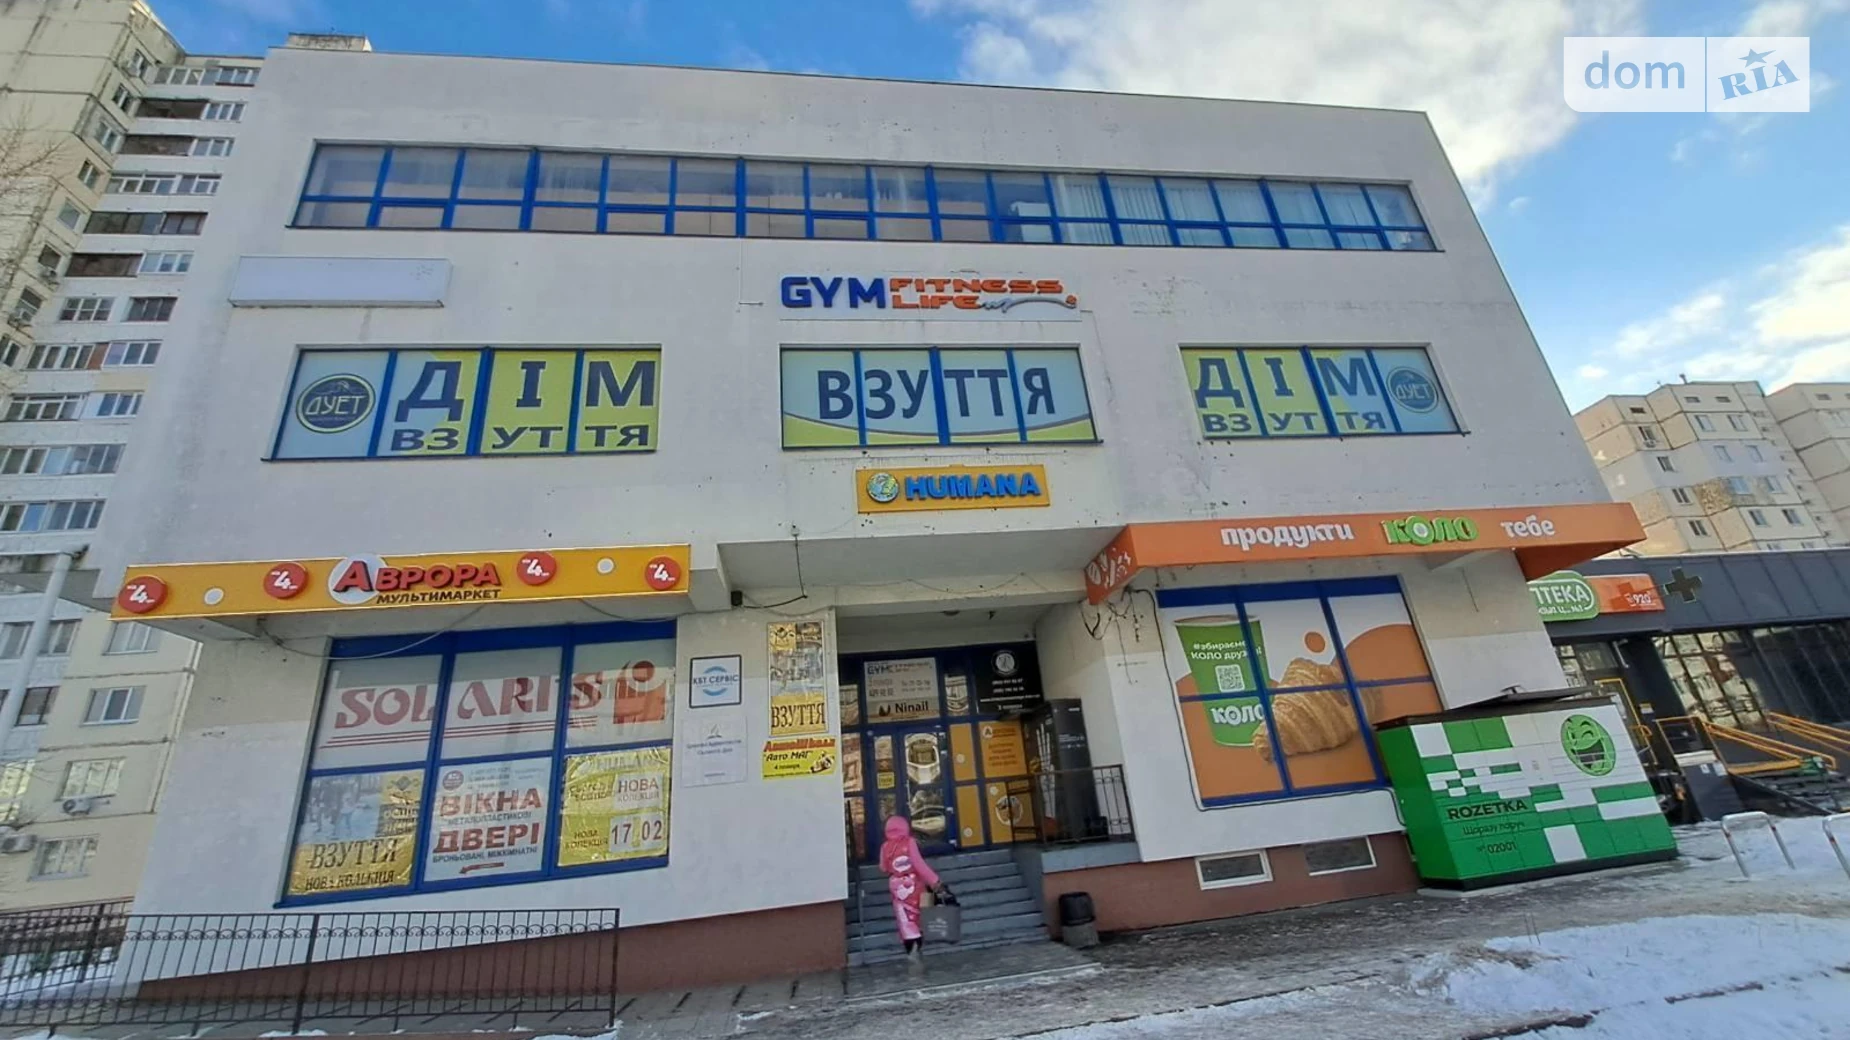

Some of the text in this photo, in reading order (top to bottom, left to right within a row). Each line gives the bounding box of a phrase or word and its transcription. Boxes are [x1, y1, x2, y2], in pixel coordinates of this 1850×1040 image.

[781, 276, 886, 309] GYM
[889, 278, 1063, 293] FITNESS
[891, 294, 981, 309] LIFE
[394, 360, 656, 423] ДІМ
[817, 367, 1055, 419] ВЗУТТЯ
[1194, 357, 1377, 409] ДІМ
[1202, 411, 1387, 433] ВЗУТТЯ
[390, 424, 650, 450] ВЗУТТЯ
[904, 473, 1041, 500] HUMANA
[1221, 522, 1354, 551] продукти
[1500, 515, 1555, 538] тебе
[376, 589, 502, 605] МУЛЬТИМАРКЕТ
[1529, 584, 1590, 605] ПТЕКА
[335, 672, 603, 729] SOLARIS
[771, 703, 825, 728] ВЗУТТЯ
[618, 778, 659, 793] НОВА
[440, 787, 543, 817] ВІКНА
[1446, 800, 1528, 819] ROZETKA
[432, 822, 540, 854] ДВЕРІ
[309, 838, 398, 869] ВЗУТТЯ
